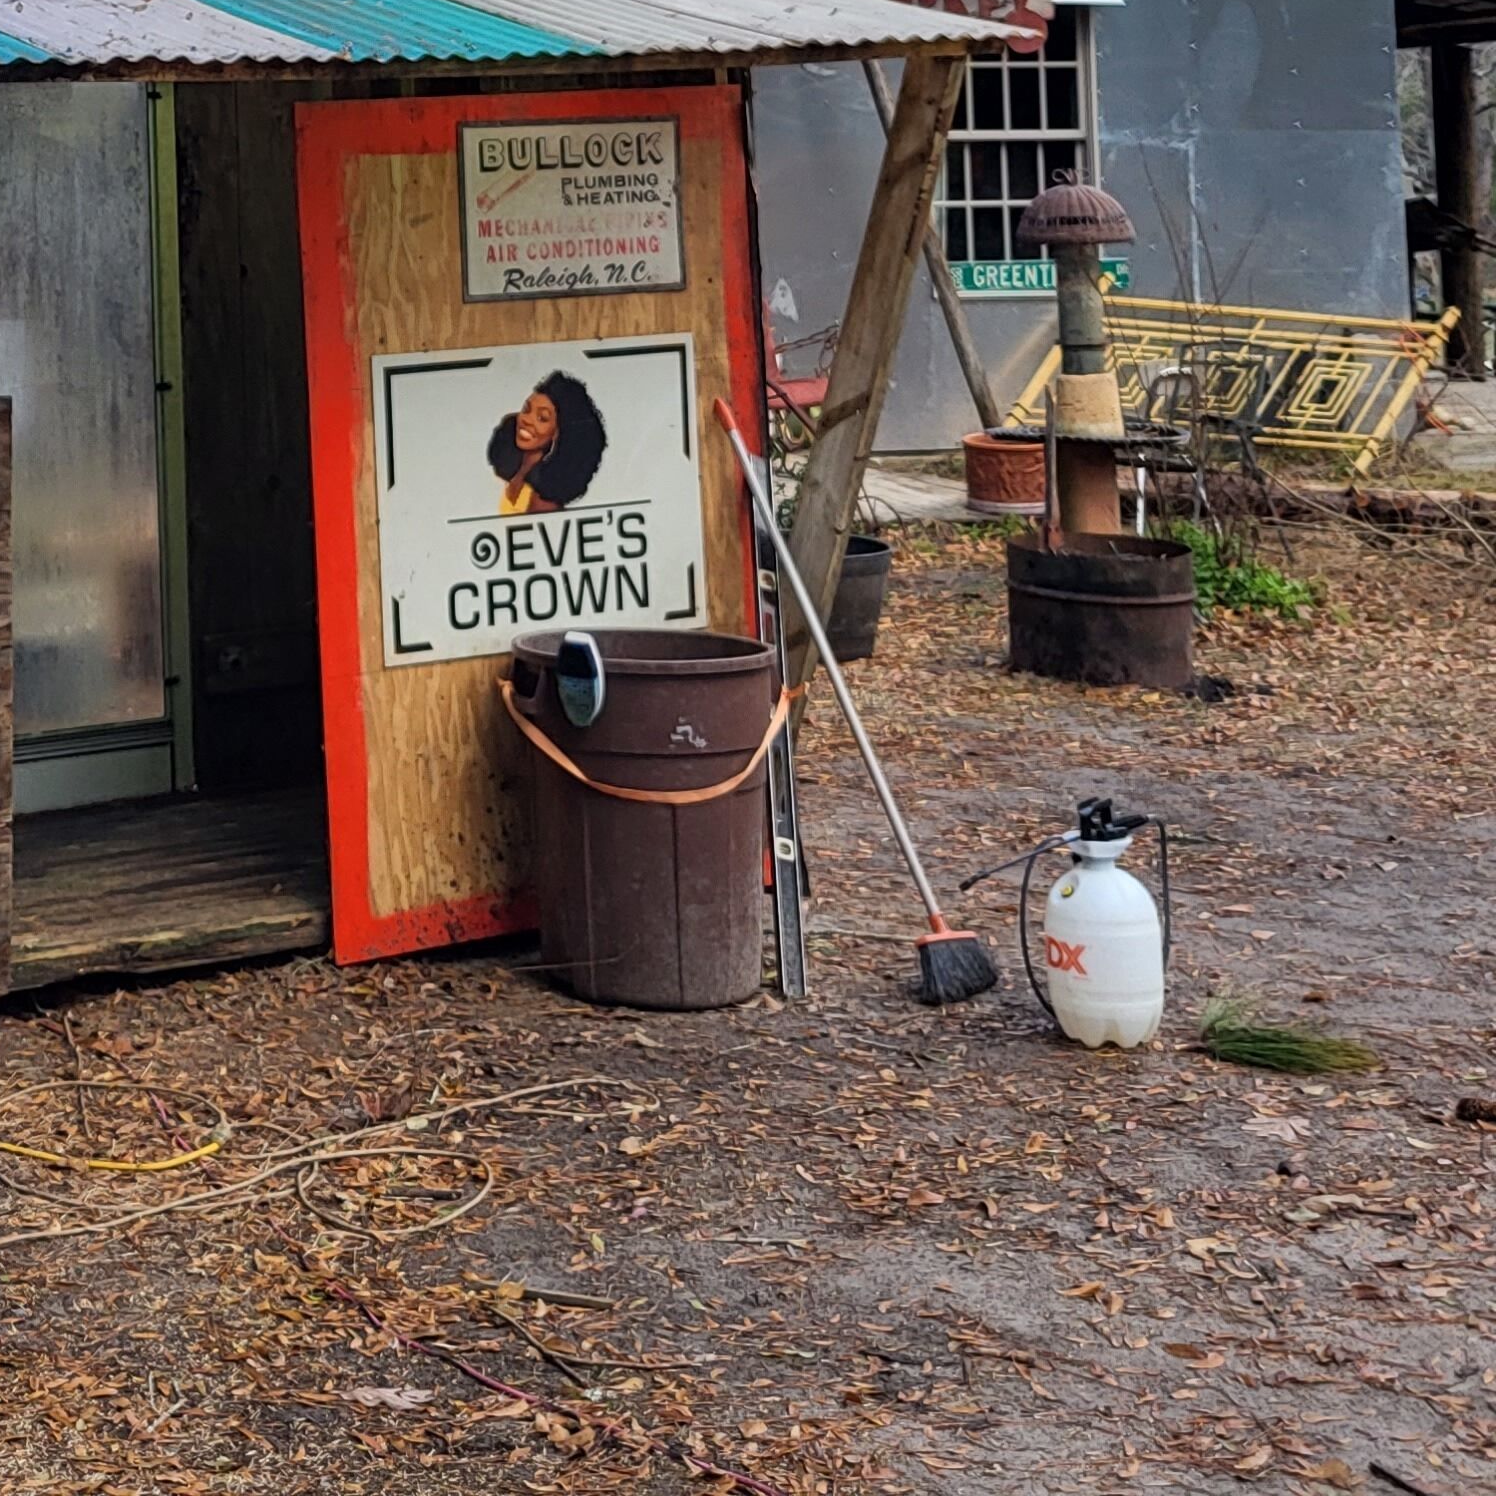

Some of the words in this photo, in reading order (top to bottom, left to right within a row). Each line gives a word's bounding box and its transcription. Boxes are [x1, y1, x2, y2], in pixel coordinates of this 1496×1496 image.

[478, 131, 664, 172] BULLOCK
[561, 173, 659, 193] PLUMBING
[486, 243, 518, 264] AIR
[527, 235, 660, 260] CONDITIONING
[604, 260, 652, 284] N.C.
[507, 509, 648, 573] EVE'S
[448, 561, 650, 630] CROWN
